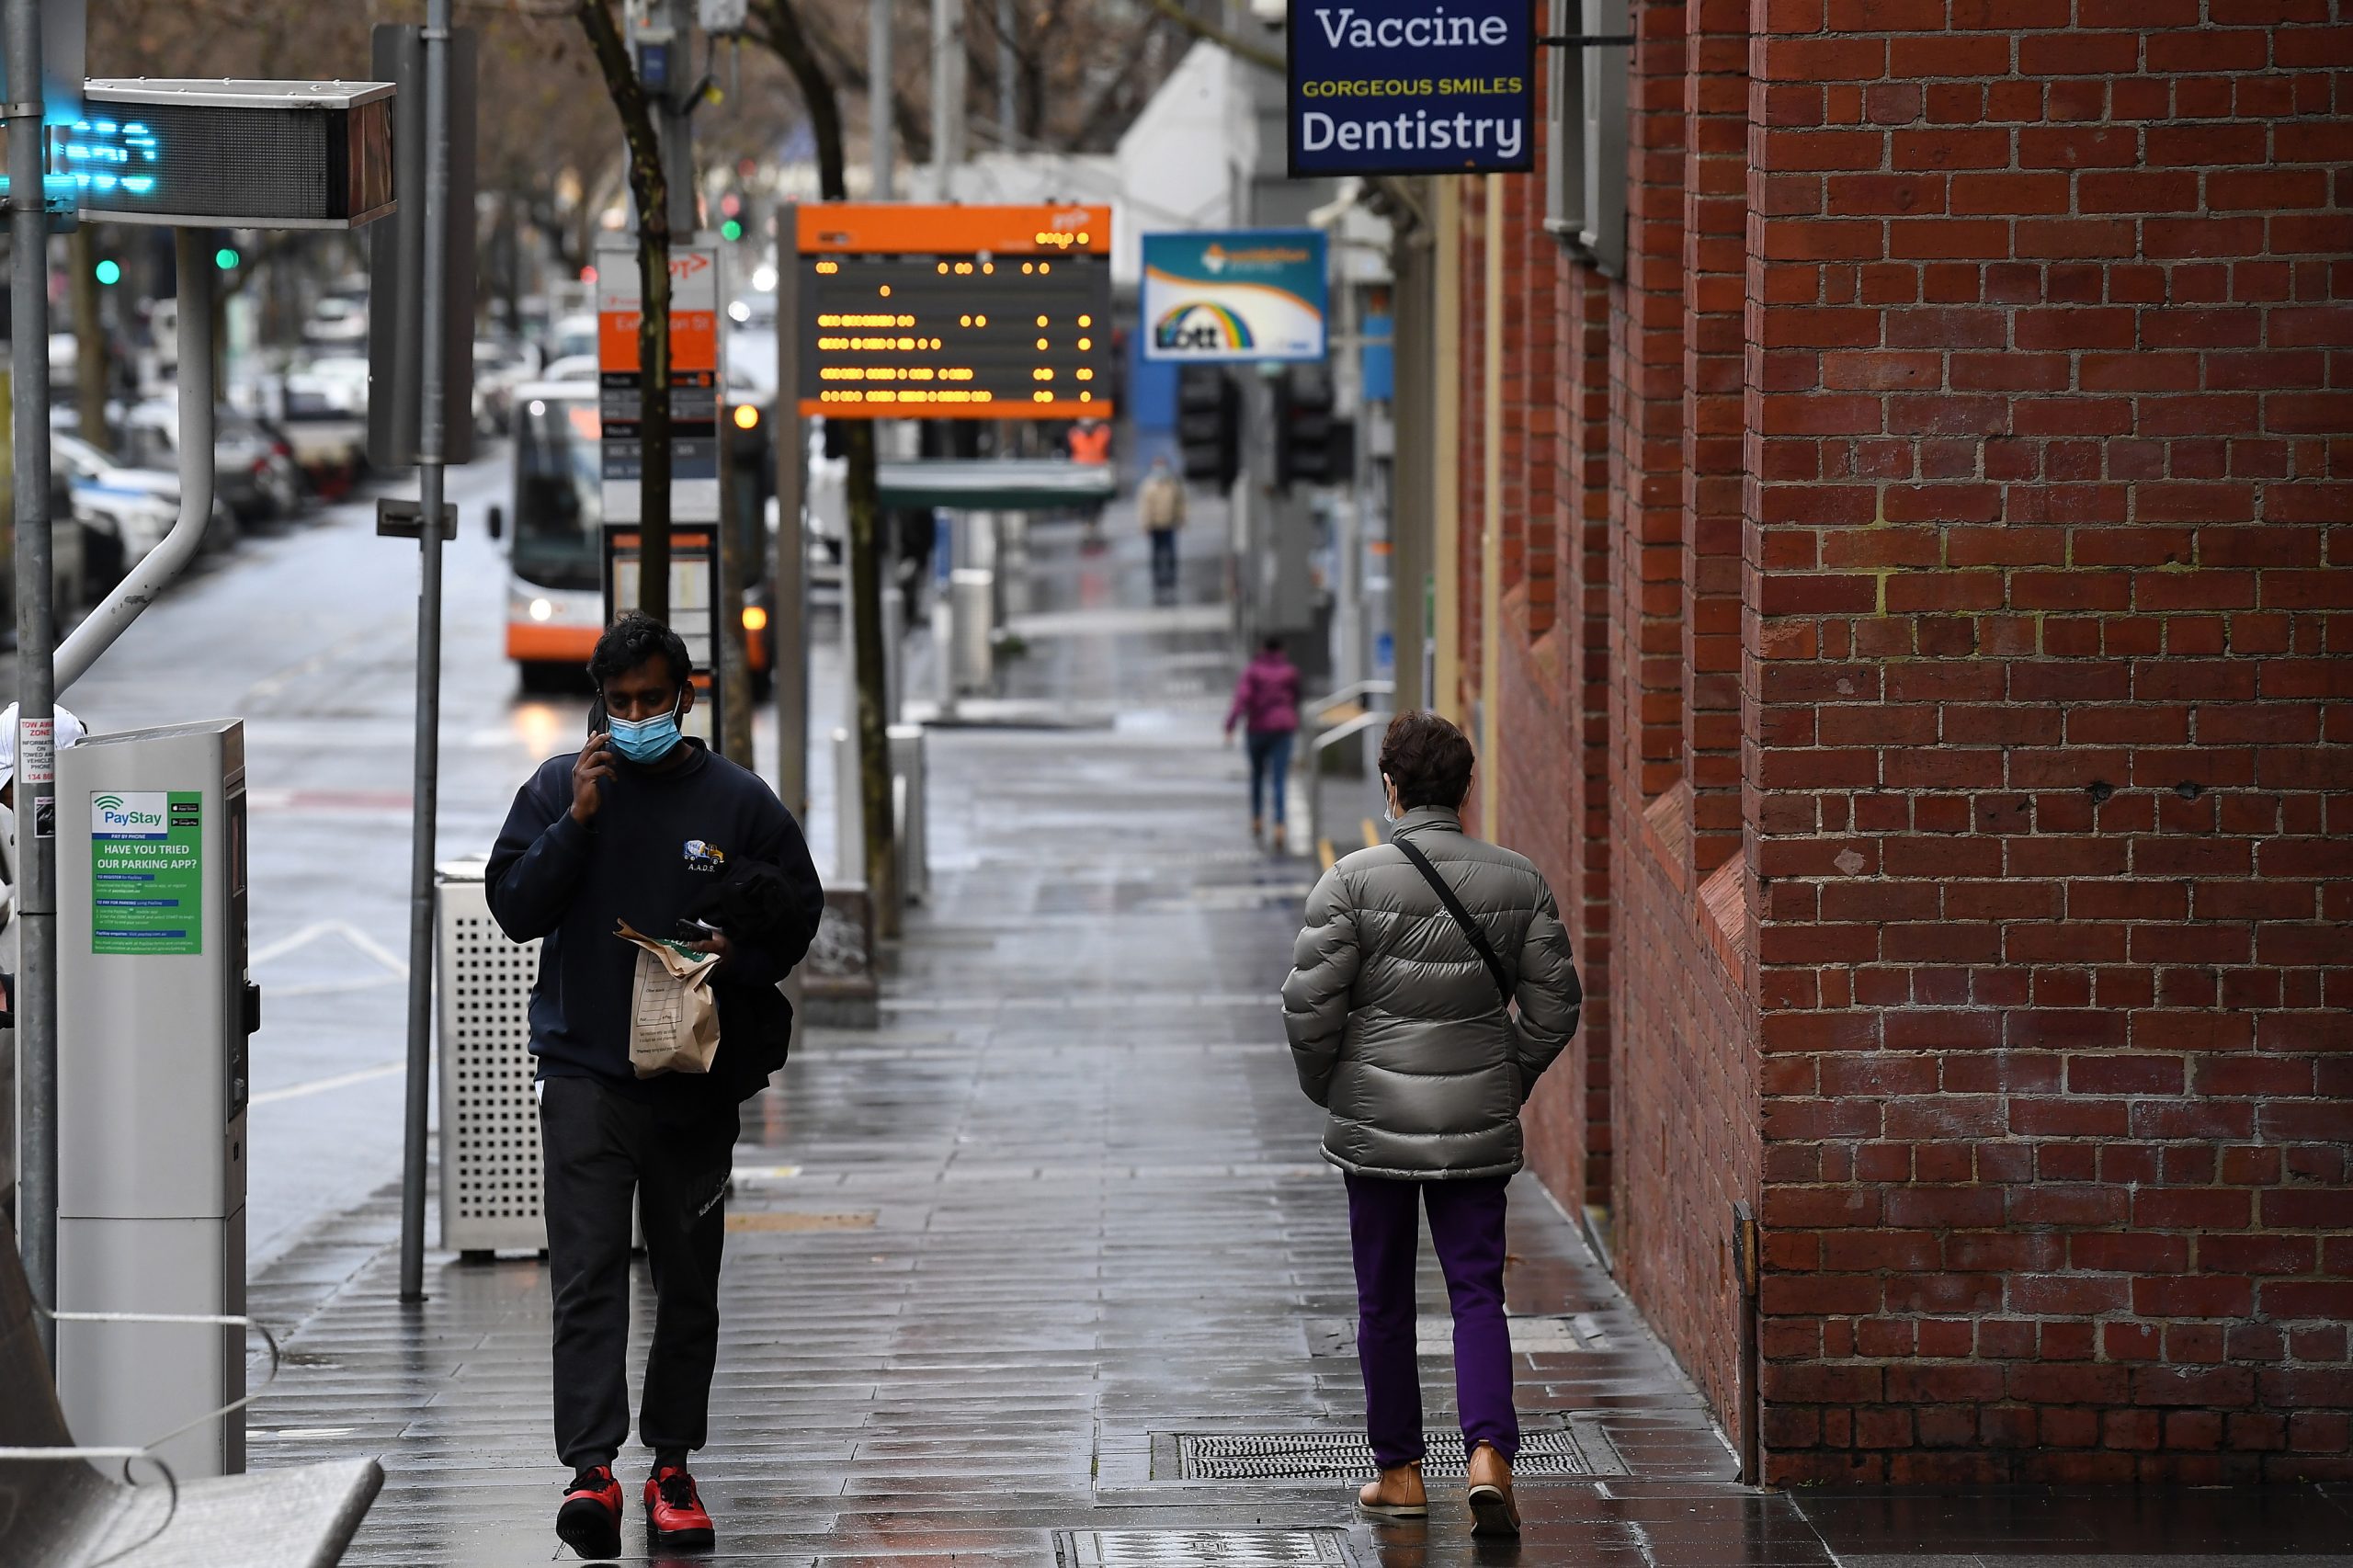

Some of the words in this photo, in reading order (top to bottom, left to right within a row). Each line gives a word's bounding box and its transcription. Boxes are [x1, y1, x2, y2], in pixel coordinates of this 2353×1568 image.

[1314, 6, 1507, 48] Vaccine
[1302, 78, 1433, 97] GORGEOUS
[1438, 77, 1523, 95] SMILES
[1302, 109, 1522, 158] Dentistry
[105, 811, 162, 826] PayStay
[104, 845, 131, 855] HAVE
[133, 845, 156, 855] YOU
[159, 845, 189, 855] TRIED
[97, 858, 119, 869] OUR
[121, 858, 168, 869] PARKING
[170, 858, 198, 869] APP?
